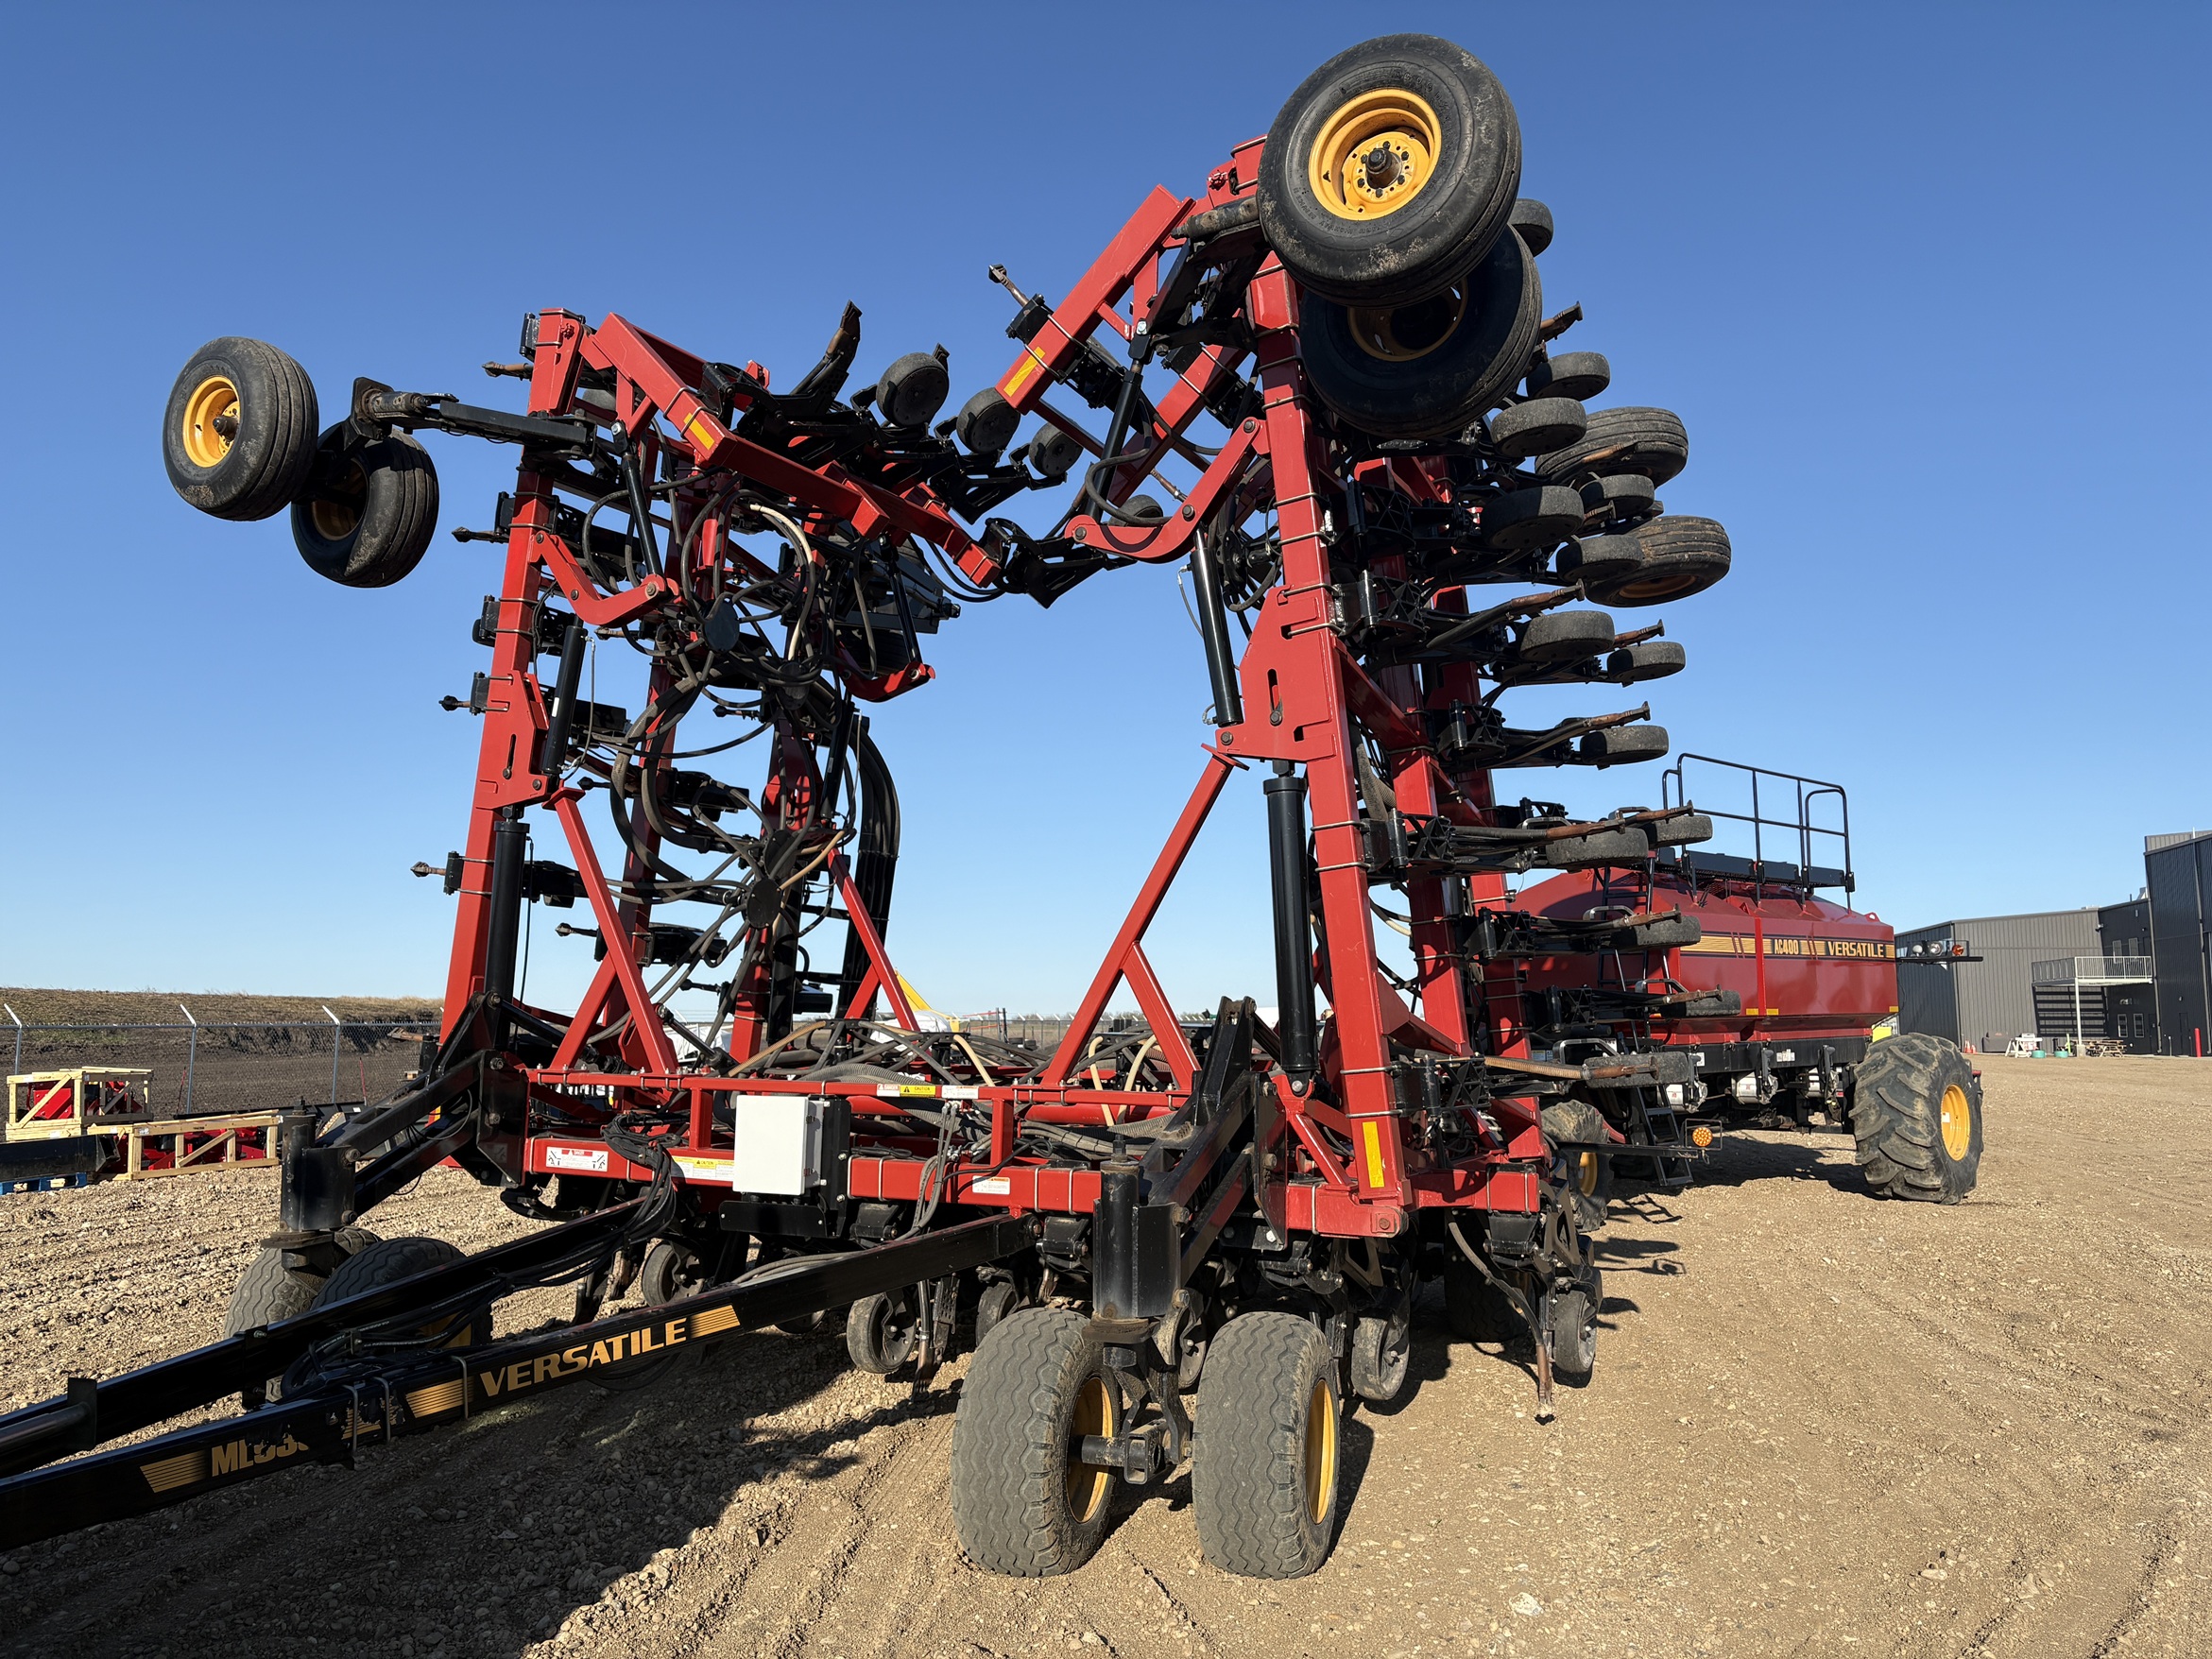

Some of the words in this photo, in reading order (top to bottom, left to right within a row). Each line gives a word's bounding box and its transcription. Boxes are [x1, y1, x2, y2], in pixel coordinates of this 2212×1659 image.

[1775, 938, 1799, 955] AC400
[1827, 941, 1884, 957] VERSATILE
[479, 1317, 688, 1397] VERSATILE
[211, 1431, 310, 1478] ML93
